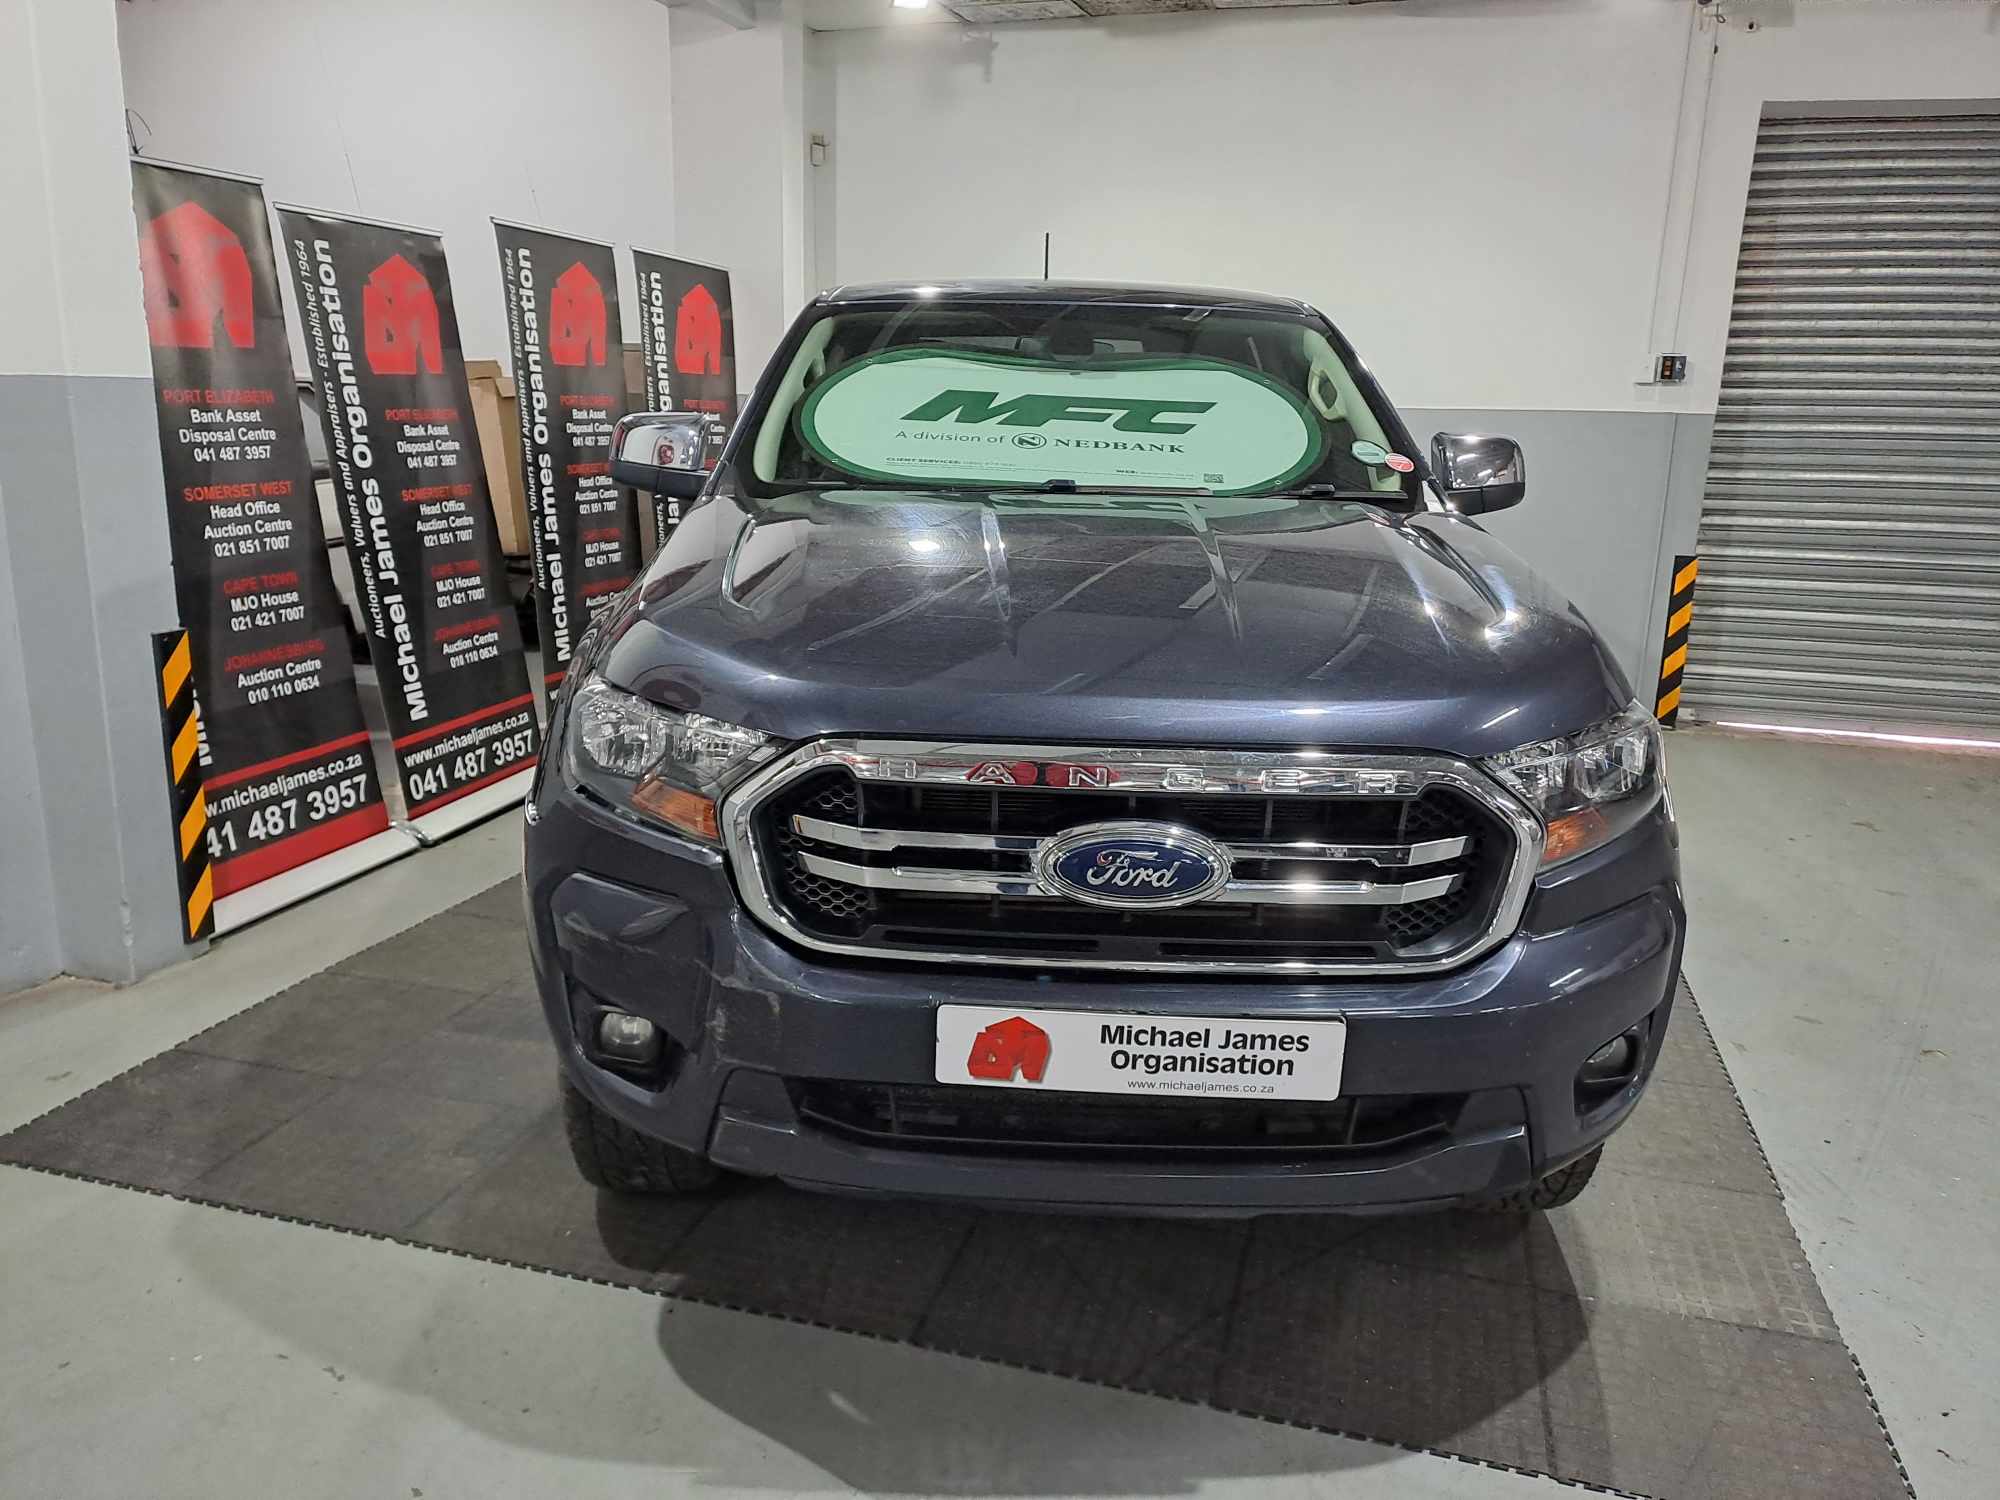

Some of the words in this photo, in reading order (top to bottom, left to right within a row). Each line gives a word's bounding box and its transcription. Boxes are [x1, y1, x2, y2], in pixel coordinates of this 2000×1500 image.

[294, 239, 311, 280] 1964
[301, 284, 330, 369] Established
[507, 283, 522, 358] Established
[163, 389, 200, 404] PORT
[190, 409, 223, 424] Bank
[226, 408, 262, 422] Asset
[322, 380, 348, 459] Appraisers
[900, 389, 1218, 434] MFC
[179, 428, 235, 445] Disposal
[238, 427, 276, 442] Centre
[404, 425, 426, 437] Bank
[428, 424, 449, 436] Asset
[895, 430, 908, 440] A
[914, 431, 981, 444] division
[987, 434, 1005, 444] of
[1054, 438, 1185, 454] NEDBANK
[194, 448, 216, 462] 041
[220, 446, 240, 460] 487
[246, 445, 271, 460] 3957
[396, 440, 434, 455] Disposal
[436, 440, 460, 452] Centre
[407, 457, 422, 469] 041
[424, 456, 438, 468] 487
[339, 461, 355, 492] and
[526, 467, 538, 512] Valuers
[184, 483, 257, 502] SOMERSET
[260, 480, 293, 496] WEST
[538, 453, 560, 546] James
[210, 503, 242, 519] Head
[244, 501, 280, 516] Office
[347, 494, 366, 548] Valuers
[420, 503, 442, 516] Head
[442, 500, 465, 512] Office
[204, 524, 252, 540] Auction
[255, 519, 293, 534] Centre
[362, 478, 398, 586] James
[416, 518, 448, 532] Auction
[450, 515, 474, 528] Centre
[214, 543, 236, 558] 021
[238, 541, 260, 555] 851
[264, 535, 290, 551] 7007
[424, 535, 439, 547] 021
[360, 551, 387, 639] Auctioneers,
[455, 576, 480, 589] House
[230, 597, 258, 612] MJO
[261, 591, 299, 608] House
[437, 596, 452, 608] 021
[546, 553, 572, 662] Michael
[231, 617, 252, 632] 021
[255, 612, 277, 626] 421
[280, 606, 304, 622] 7007
[384, 594, 428, 722] Michael
[442, 640, 472, 655] Auction
[238, 669, 284, 688] Auction
[286, 658, 322, 676] Centre
[248, 688, 269, 704] 010
[272, 683, 292, 699] 110
[295, 676, 320, 692] 0634
[404, 712, 529, 768] www.michaeljames.co.za
[410, 763, 448, 801] 041
[454, 747, 486, 781] 487
[492, 728, 533, 766] 3957
[248, 799, 297, 841] 487
[306, 773, 368, 821] 3957
[1087, 850, 1180, 890] Ford
[1100, 1023, 1212, 1049] Michael
[1218, 1028, 1310, 1053] James
[1110, 1048, 1294, 1077] Organisation
[1126, 1079, 1274, 1094] www.michaeljames.co.za
